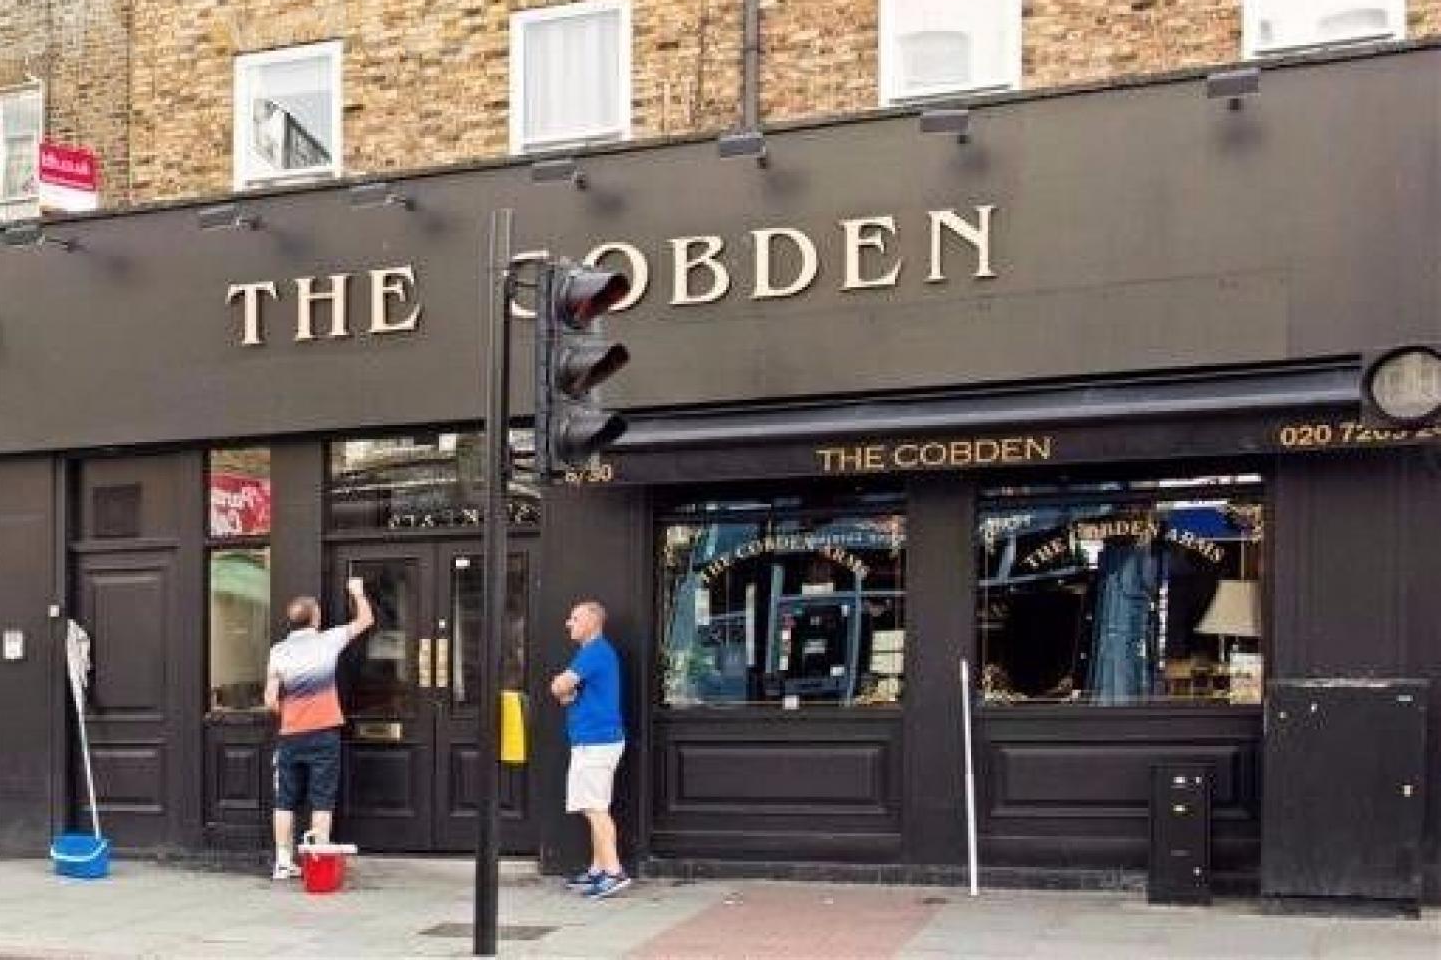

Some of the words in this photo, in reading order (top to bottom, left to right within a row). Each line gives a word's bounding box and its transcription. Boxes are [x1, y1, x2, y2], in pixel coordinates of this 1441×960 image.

[226, 265, 421, 345] THE
[1280, 424, 1332, 446] 020
[815, 445, 885, 471] THE
[893, 436, 1054, 467] COBDEN
